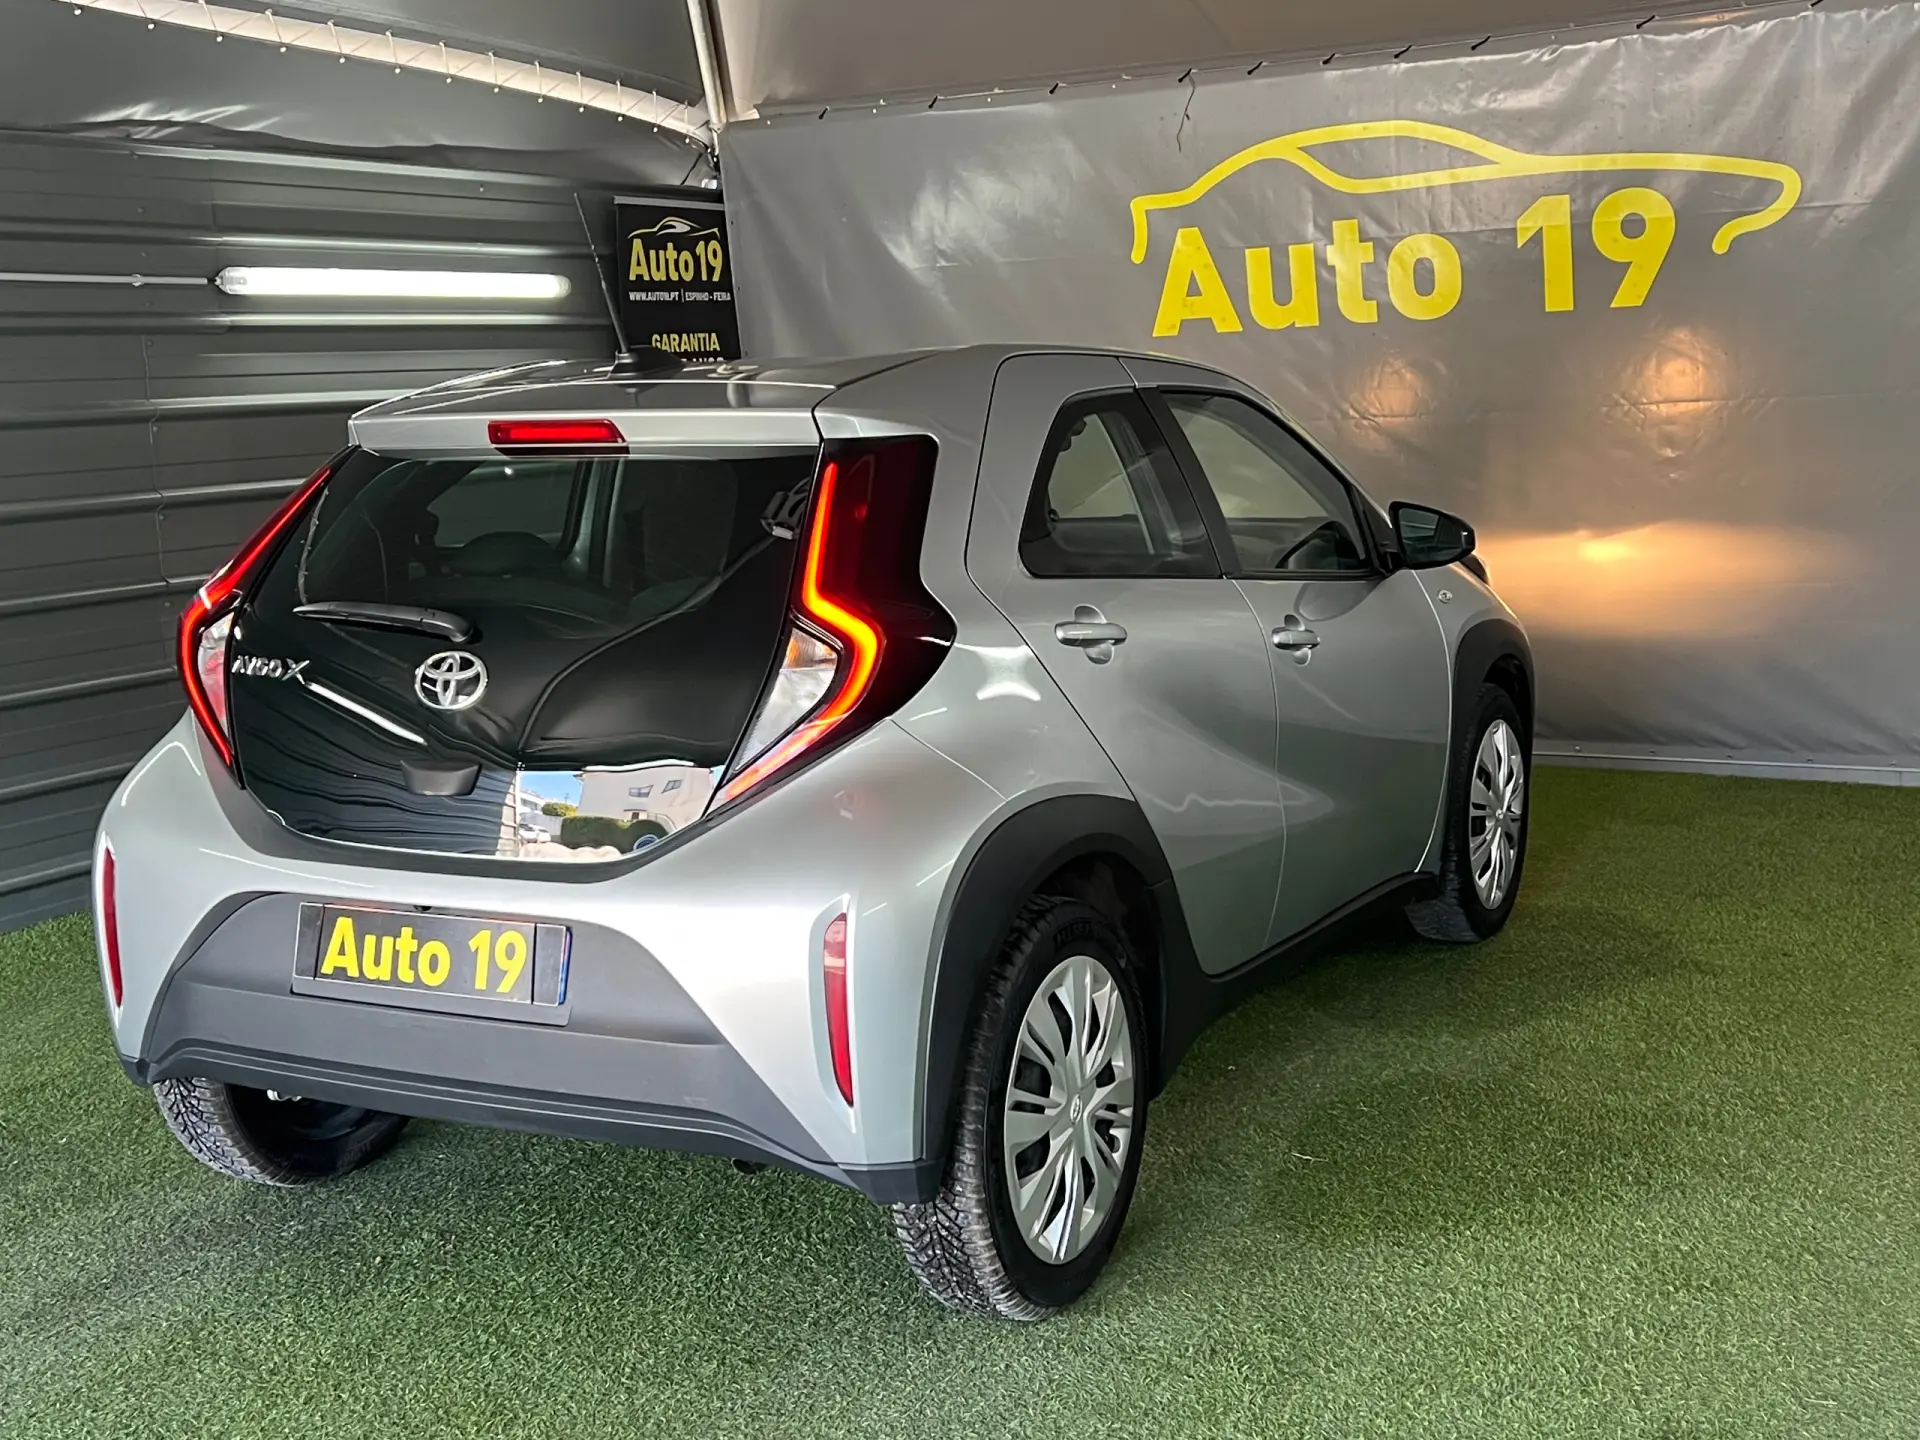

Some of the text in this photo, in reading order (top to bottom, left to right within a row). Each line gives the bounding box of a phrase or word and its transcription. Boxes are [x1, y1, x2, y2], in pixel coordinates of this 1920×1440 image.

[628, 238, 723, 282] Auto 19
[1152, 187, 1676, 337] Auto 19
[713, 291, 731, 301] FEIRA
[651, 332, 721, 353] GARANTIA
[231, 654, 283, 679] AYGO
[320, 916, 527, 993] Auto 19
